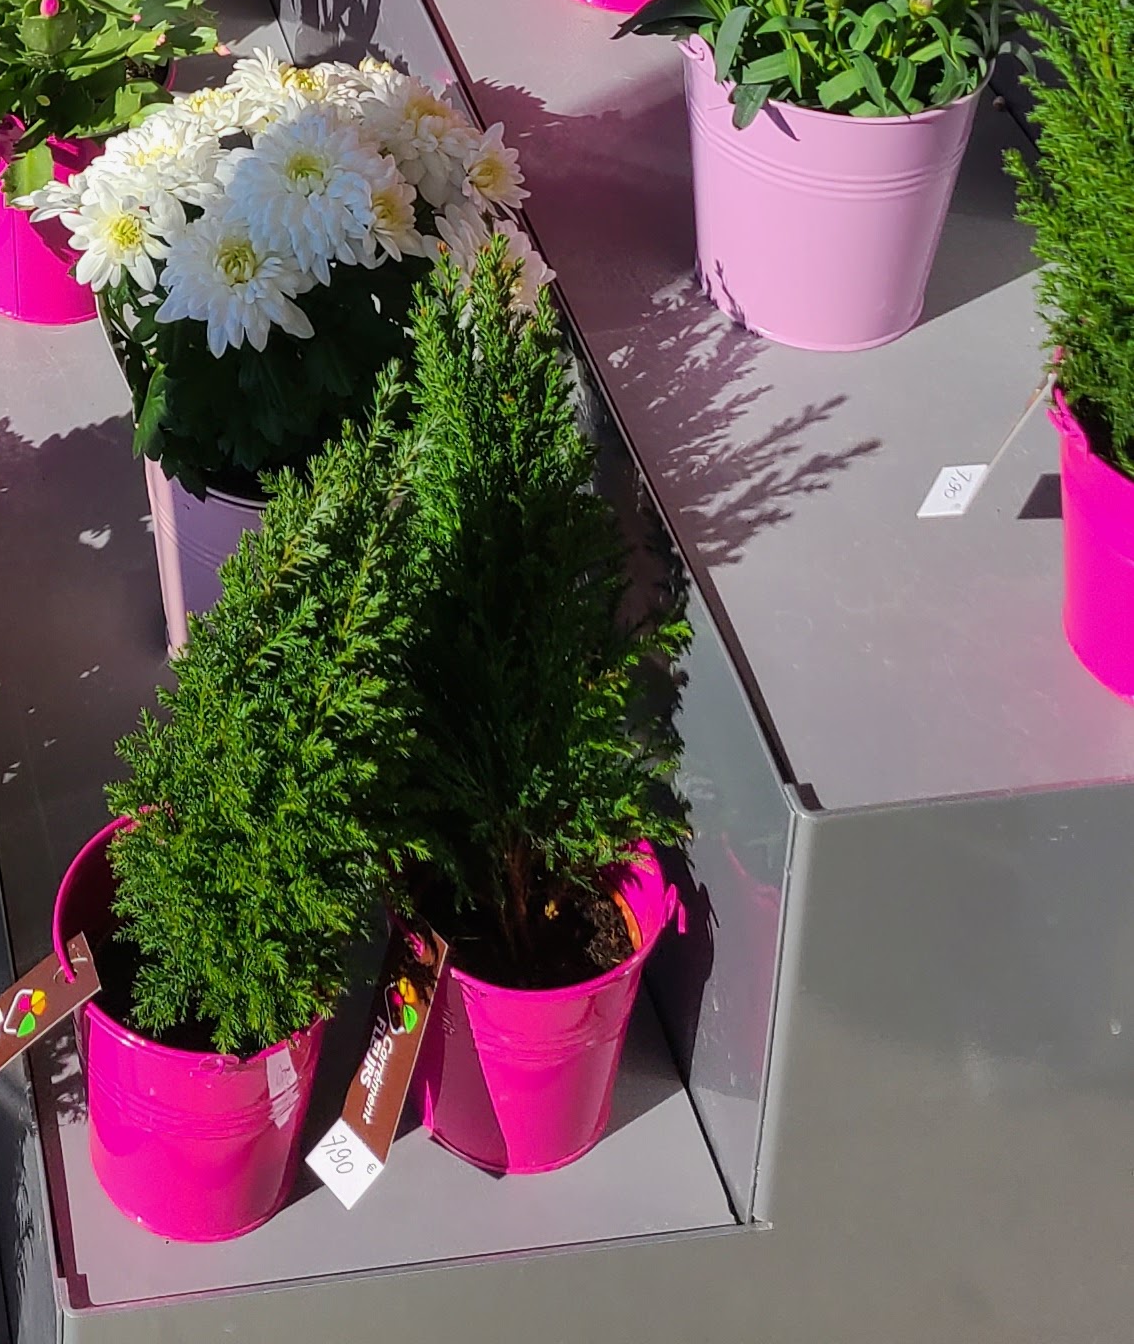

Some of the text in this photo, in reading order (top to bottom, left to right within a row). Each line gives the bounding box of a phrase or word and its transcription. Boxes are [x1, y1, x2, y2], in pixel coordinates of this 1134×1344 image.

[360, 1015, 387, 1088] FLEURS
[362, 1035, 392, 1124] Carrément
[321, 1135, 354, 1174] 7,90
